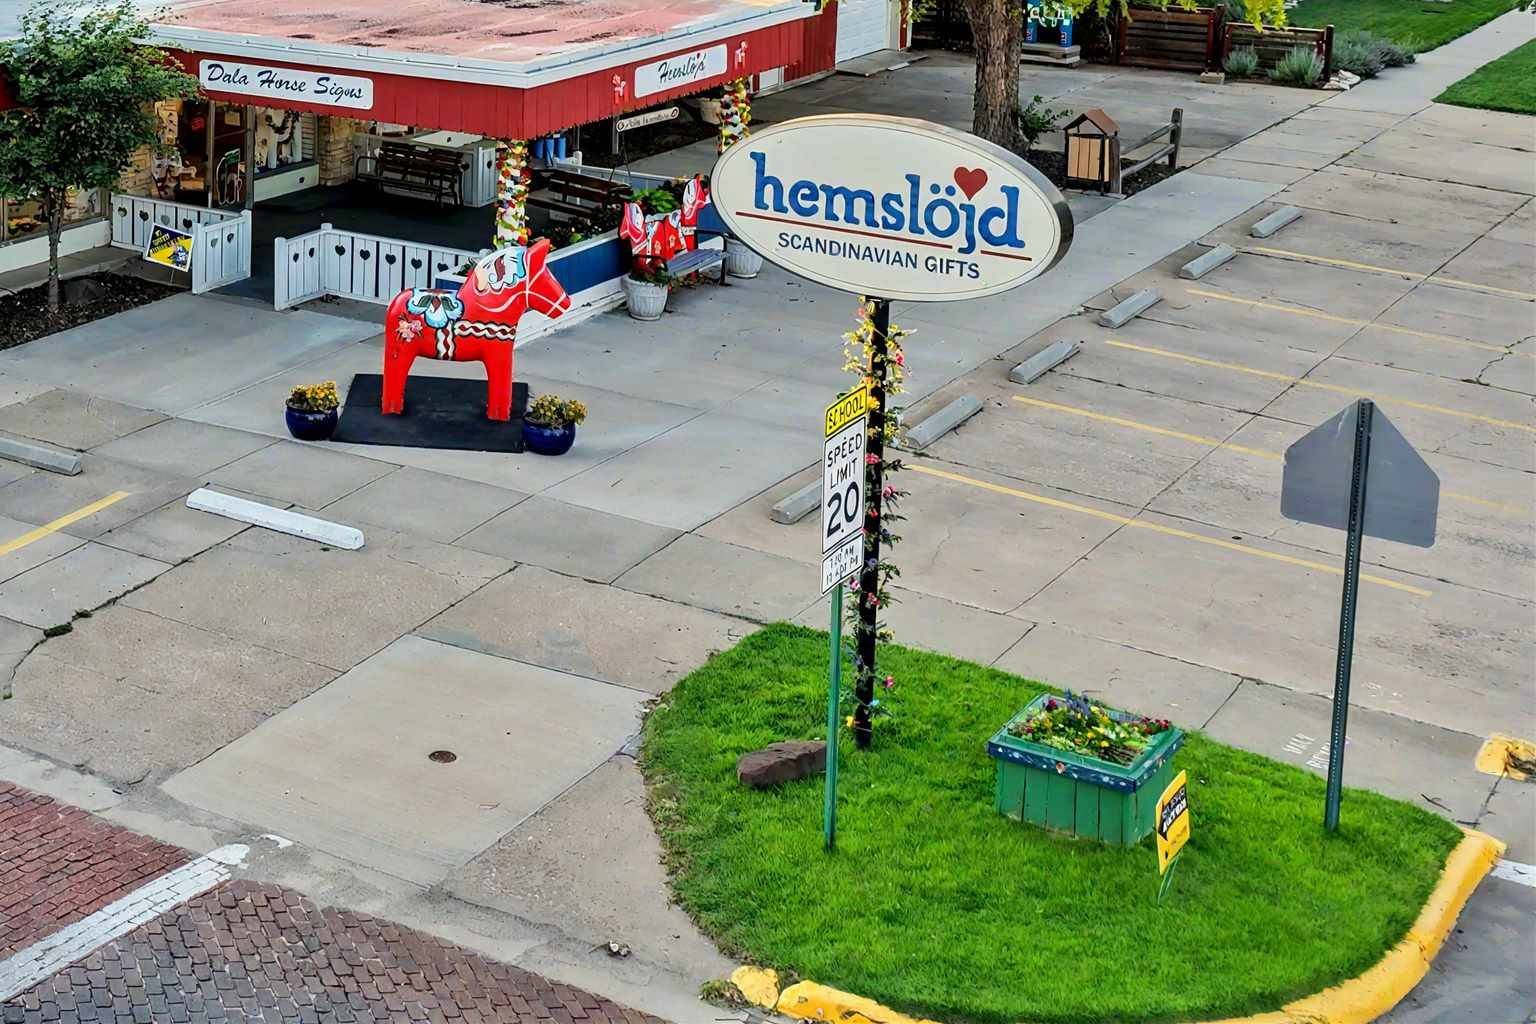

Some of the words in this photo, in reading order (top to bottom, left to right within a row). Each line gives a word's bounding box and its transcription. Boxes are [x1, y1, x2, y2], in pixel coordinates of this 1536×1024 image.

[207, 63, 249, 86] Dala
[257, 69, 307, 93] Horse
[313, 76, 364, 103] Signs
[750, 152, 1025, 255] hemslöjd
[778, 232, 918, 269] SCANDINAVIAN
[925, 255, 980, 279] GIFTS
[828, 397, 864, 430] SCHOOL
[827, 432, 863, 468] SPEED
[830, 458, 858, 490] LIMIT
[827, 481, 860, 538] 20
